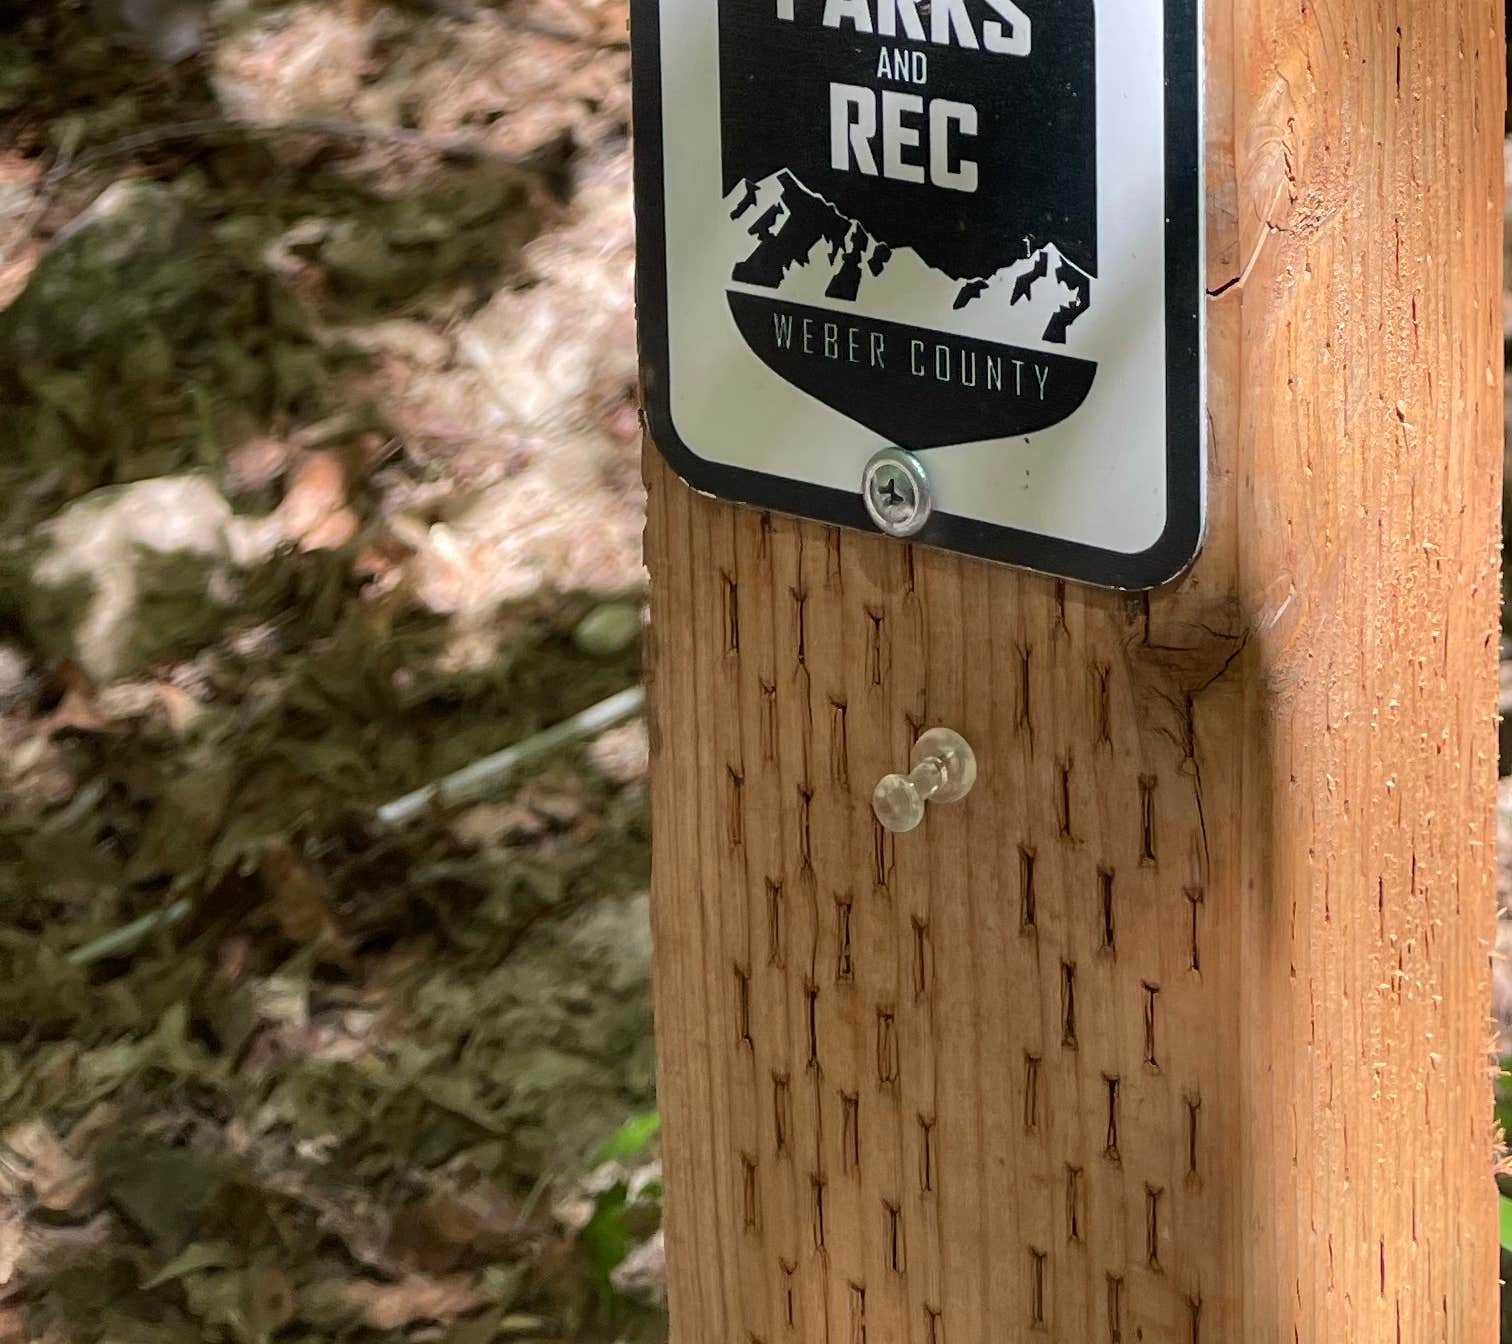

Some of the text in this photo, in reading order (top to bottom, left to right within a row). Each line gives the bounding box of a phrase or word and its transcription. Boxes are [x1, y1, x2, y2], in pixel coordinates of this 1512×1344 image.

[877, 46, 927, 85] AND
[830, 82, 978, 194] REC
[773, 312, 1050, 401] WEBER COUNTY
